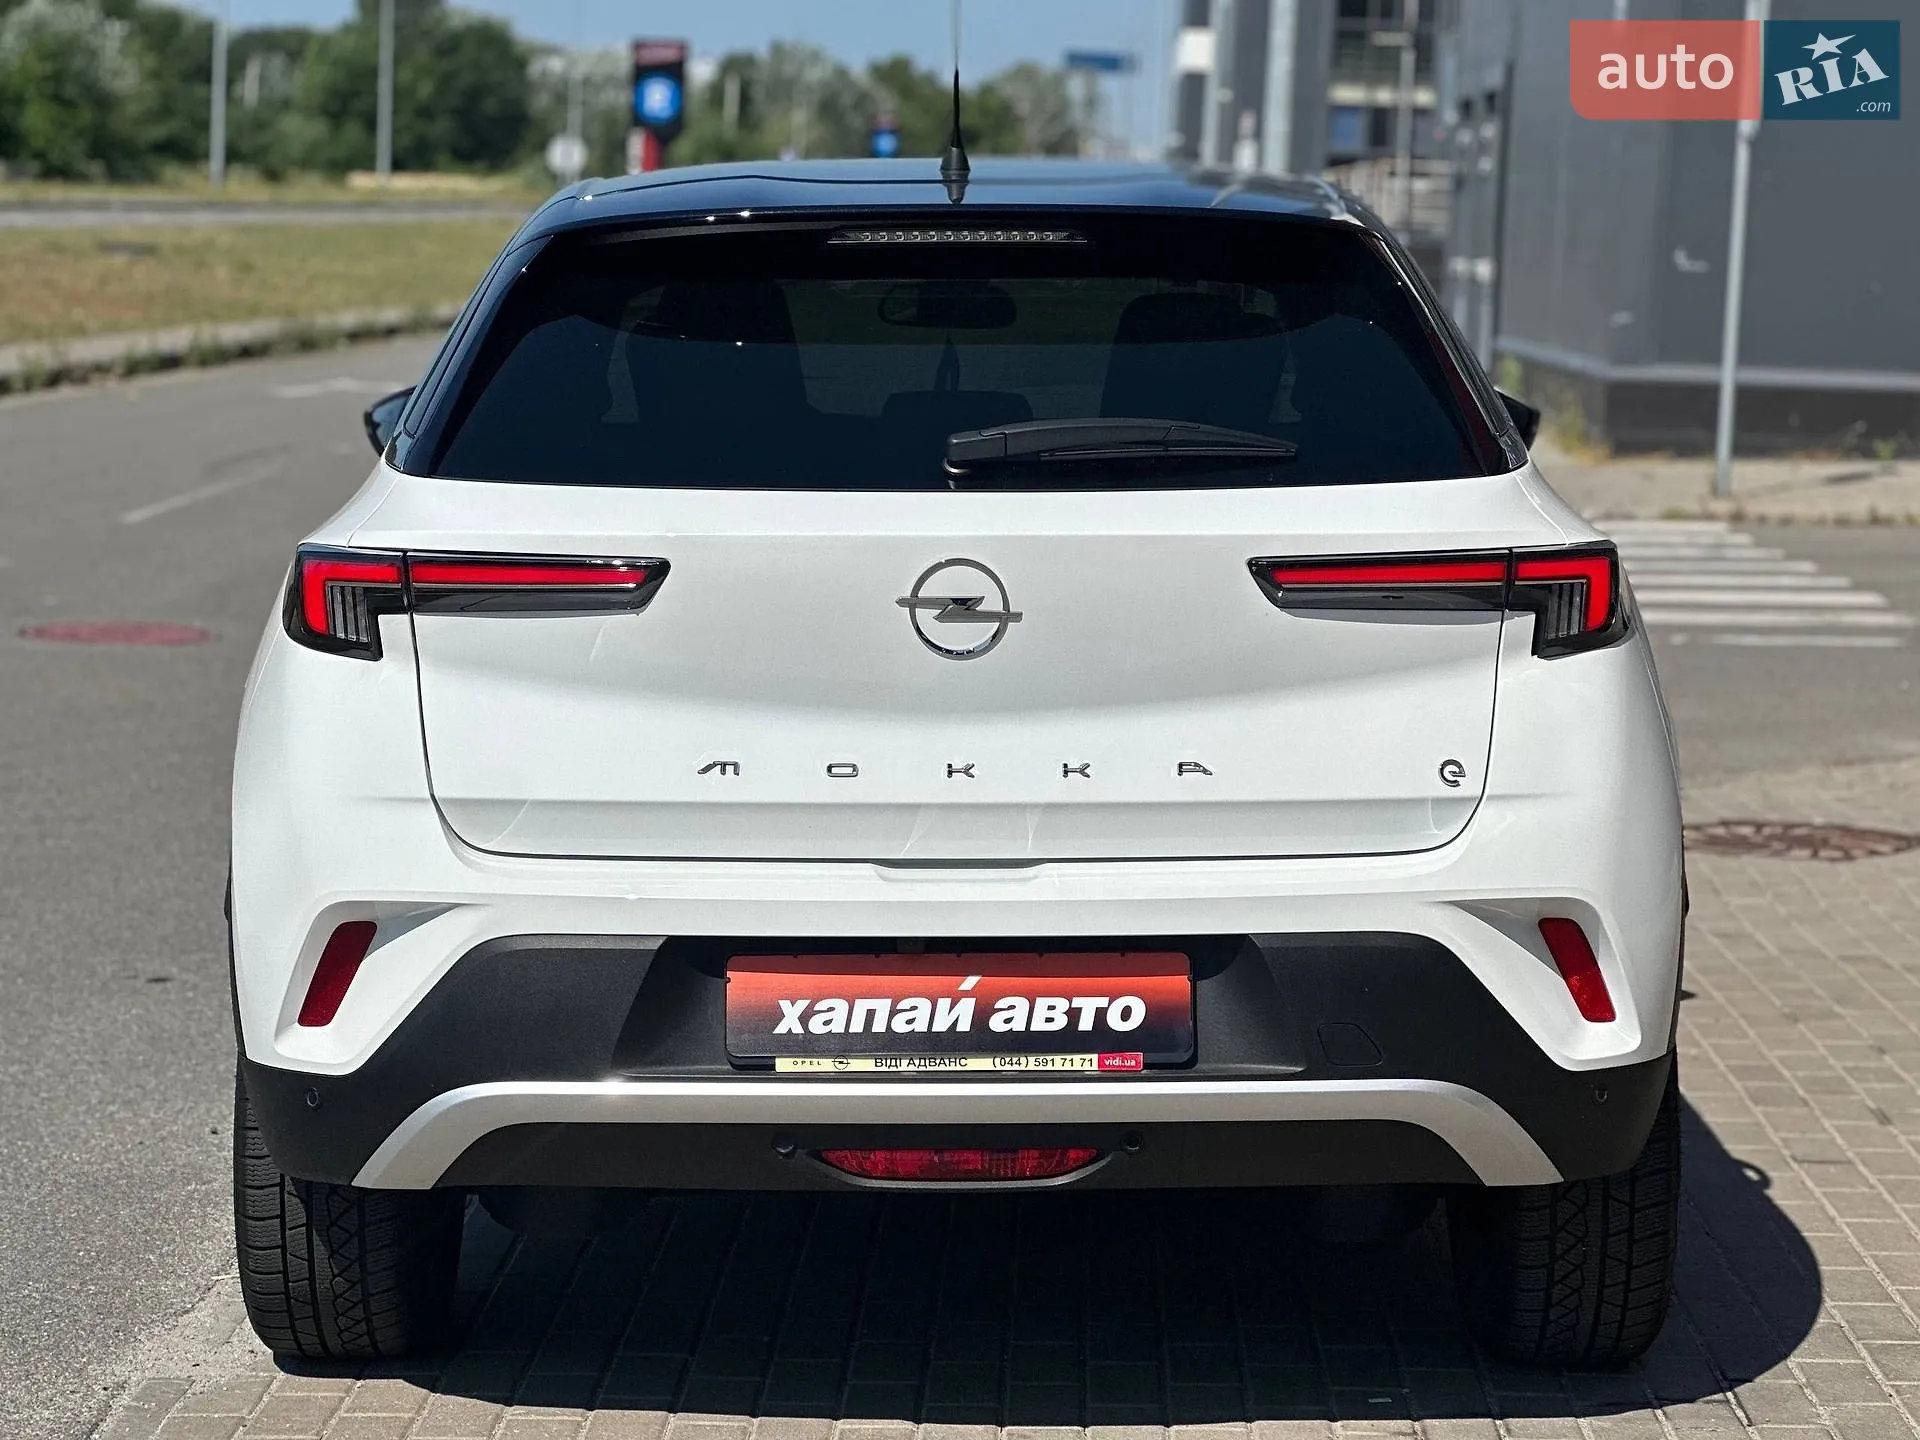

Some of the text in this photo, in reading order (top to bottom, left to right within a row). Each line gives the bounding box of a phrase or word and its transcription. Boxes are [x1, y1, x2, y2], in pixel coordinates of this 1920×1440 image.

[697, 760, 1214, 777] MOKKA
[772, 974, 1147, 1035] хапай авто
[792, 1059, 822, 1067] OPEL
[906, 1056, 968, 1069] АДВАНС
[992, 1055, 1094, 1068] (044) 591 71 71
[1104, 1057, 1136, 1067] vidi.ua
